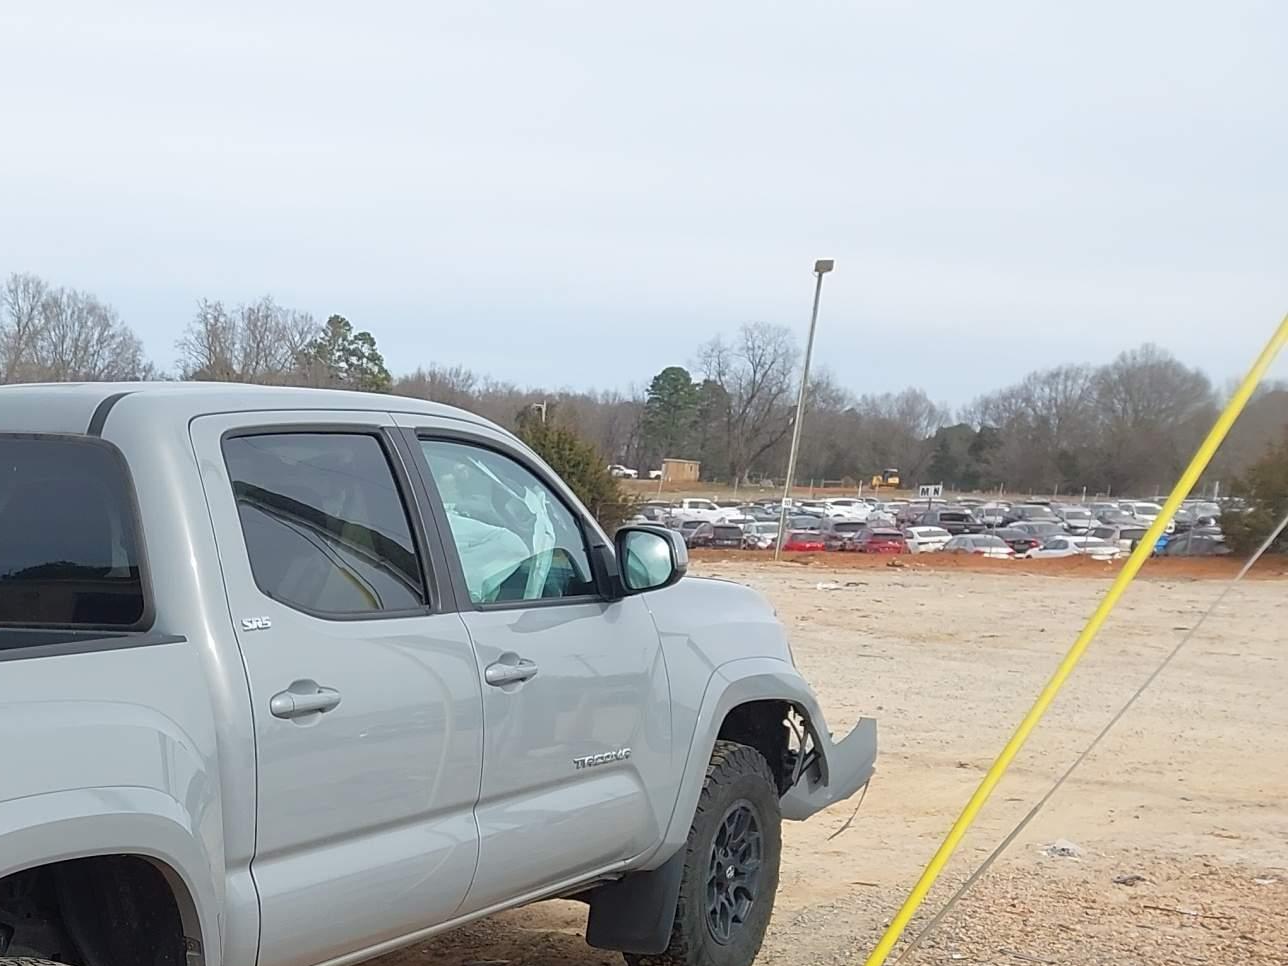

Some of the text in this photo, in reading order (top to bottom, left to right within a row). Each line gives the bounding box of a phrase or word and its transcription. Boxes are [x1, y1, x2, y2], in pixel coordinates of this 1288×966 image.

[921, 487, 940, 496] M N
[241, 616, 272, 631] SR5
[573, 747, 631, 769] TACOMA
